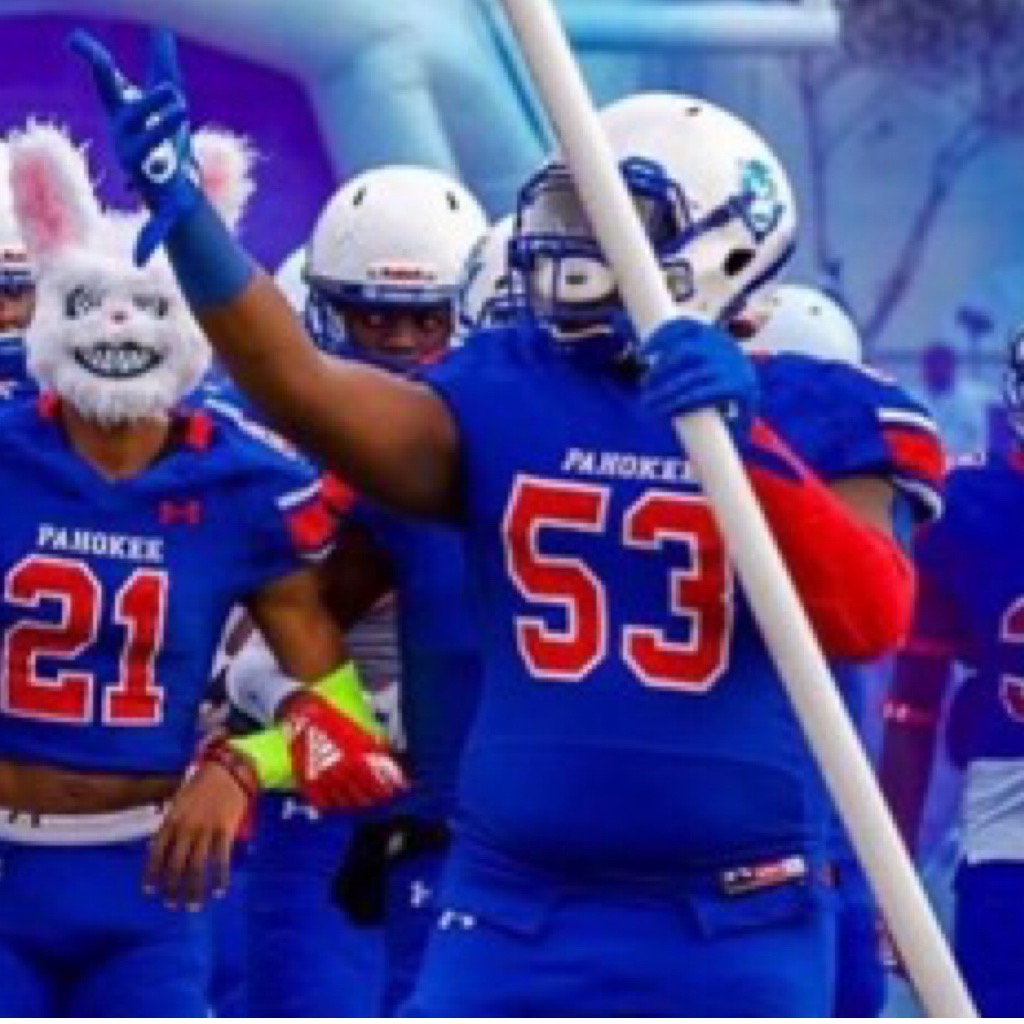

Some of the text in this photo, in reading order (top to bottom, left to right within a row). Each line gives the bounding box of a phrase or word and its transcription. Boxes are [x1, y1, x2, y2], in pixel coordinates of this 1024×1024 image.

[36, 522, 165, 562] PAHOKEE
[501, 473, 735, 692] 53
[0, 553, 169, 727] 21
